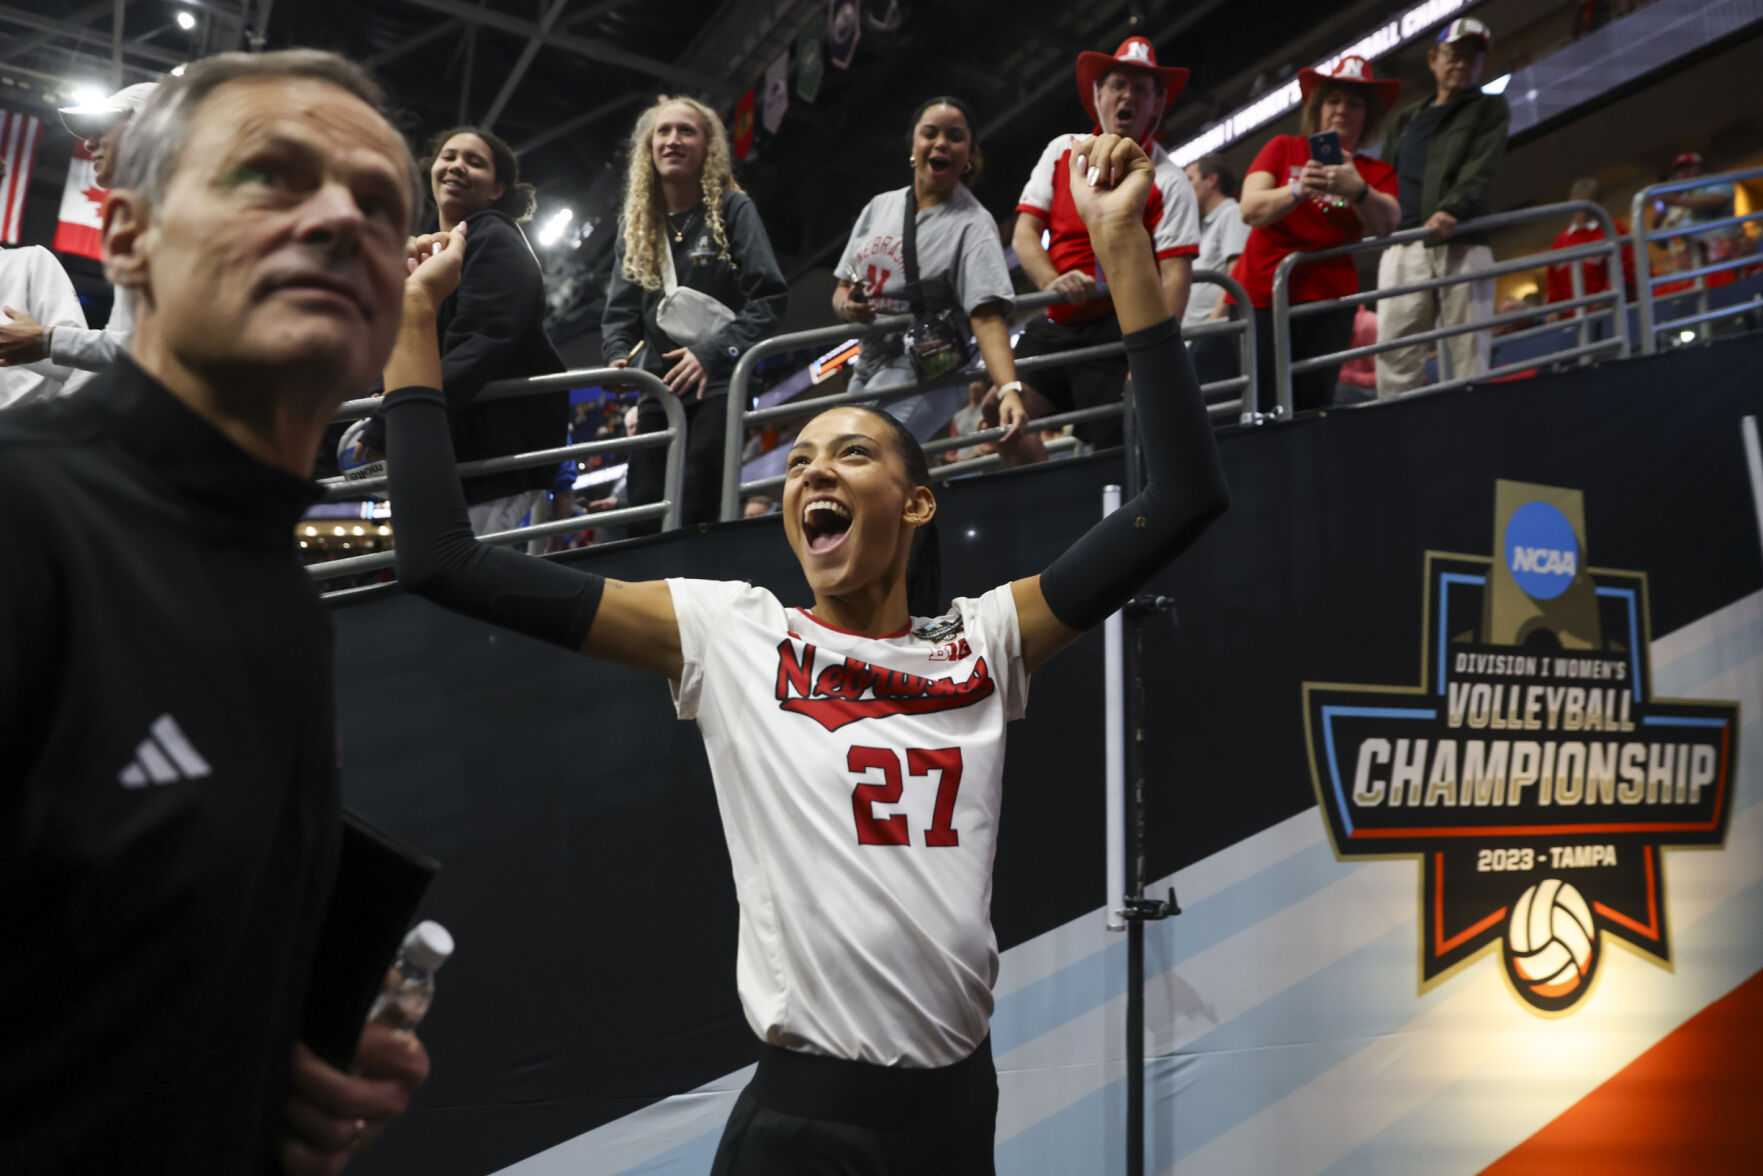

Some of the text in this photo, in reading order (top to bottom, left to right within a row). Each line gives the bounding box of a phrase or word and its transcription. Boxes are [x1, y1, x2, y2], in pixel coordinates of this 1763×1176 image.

[1126, 41, 1150, 60] N
[1341, 57, 1365, 77] N
[1513, 546, 1577, 576] NCAA
[775, 638, 996, 704] Nebra
[1455, 652, 1627, 680] DIVISION I WOMEN'S
[1447, 681, 1636, 732] VOLLEYBALL
[1352, 737, 1717, 807] CHAMPIONSHIP
[846, 745, 963, 847] 27
[1477, 848, 1535, 872] 2023
[1549, 844, 1618, 869] TAMPA
